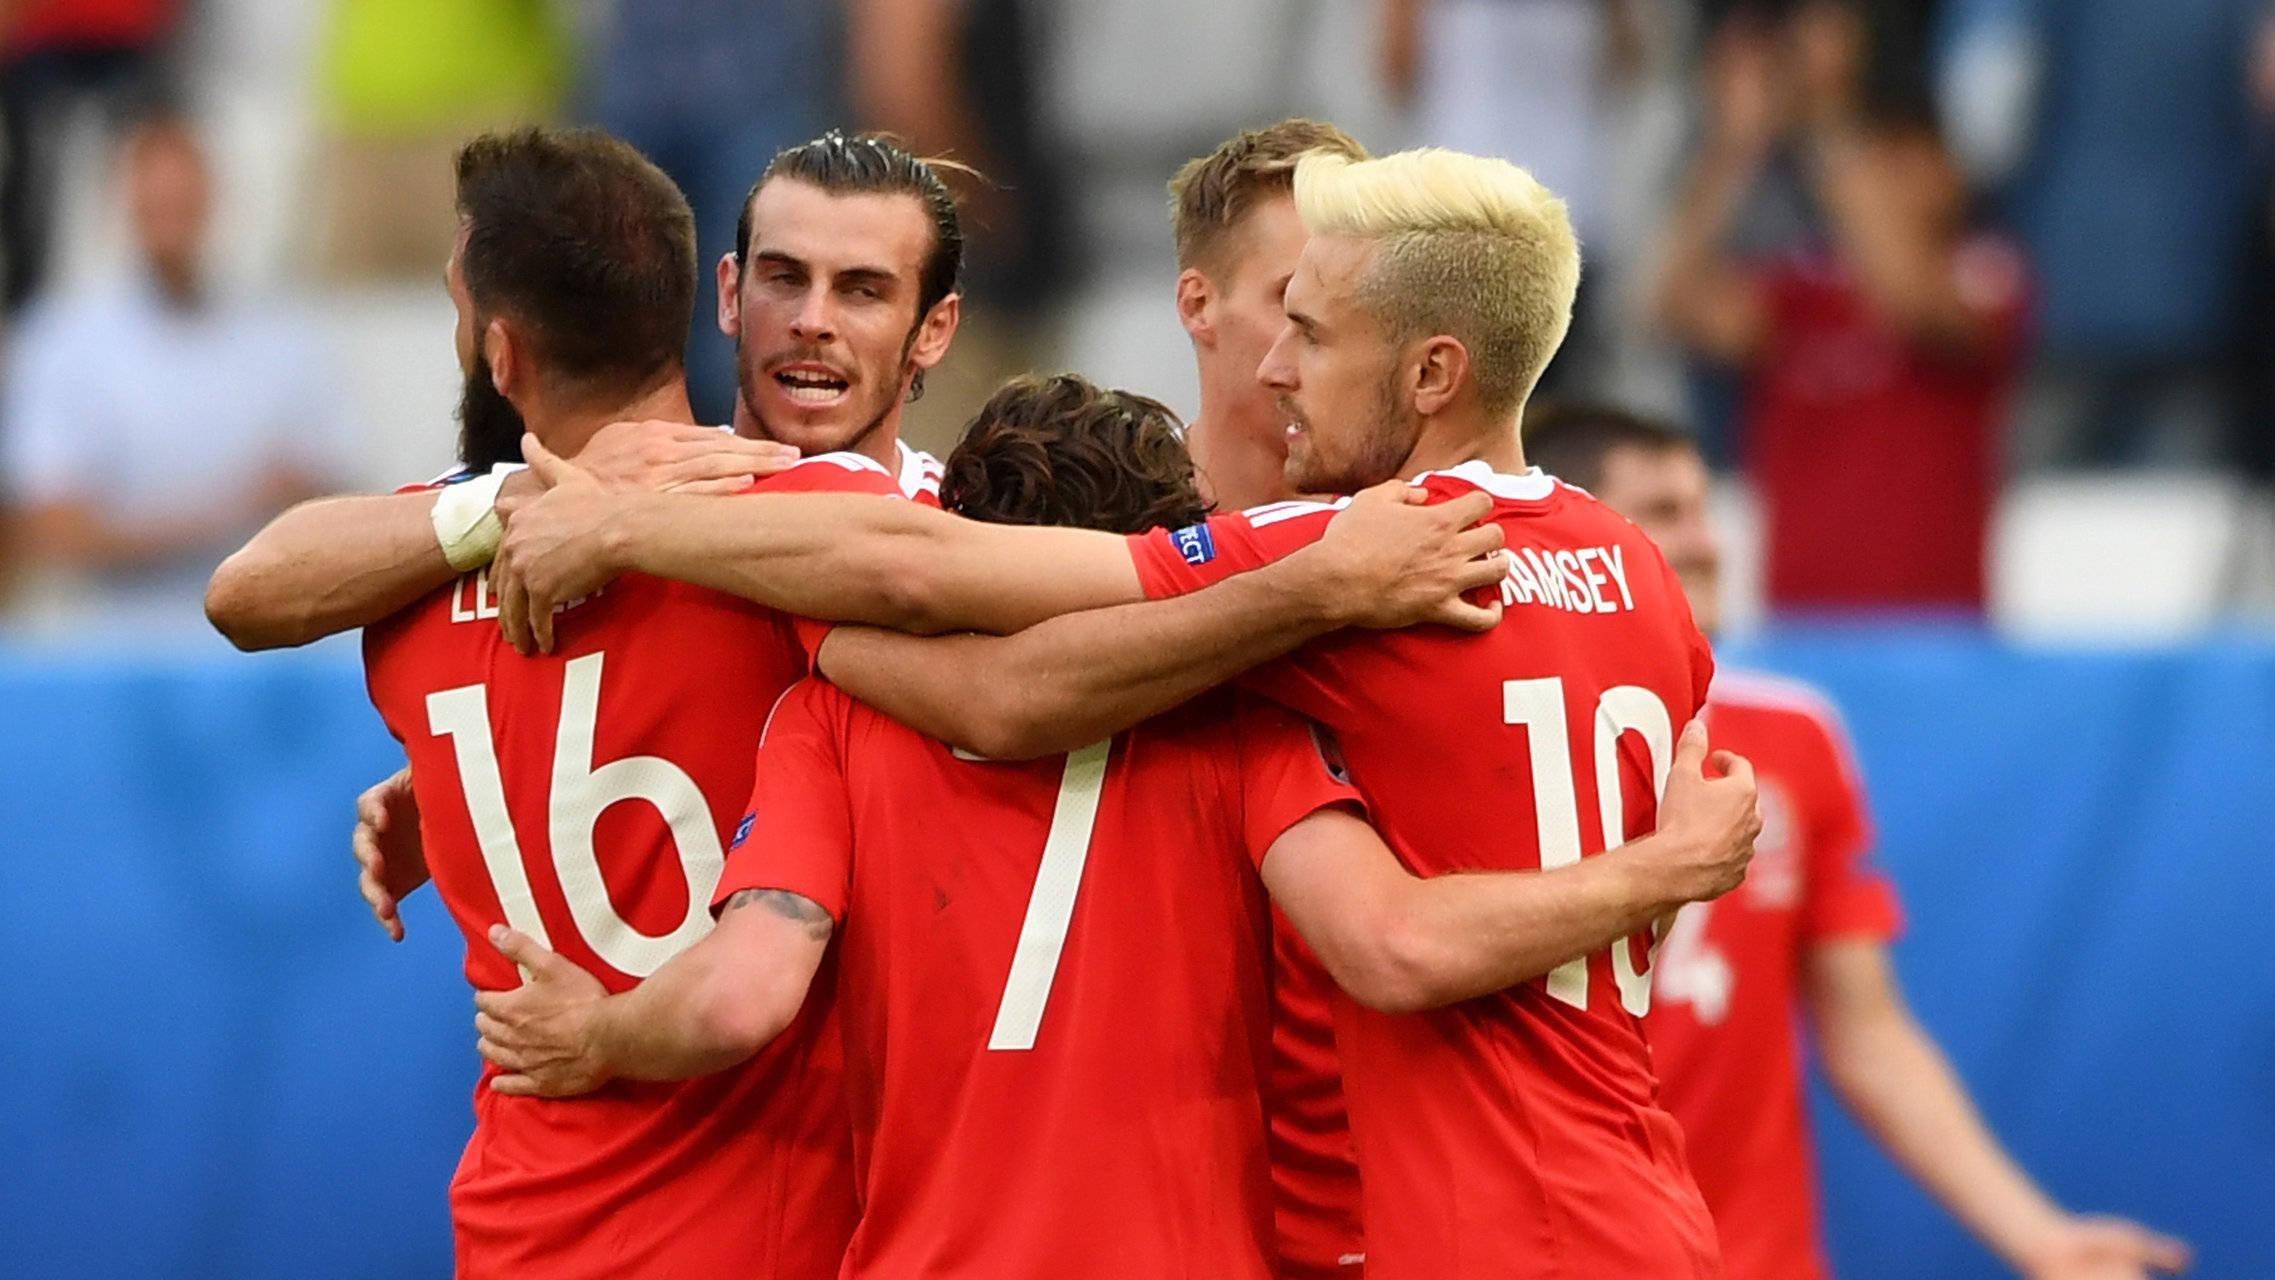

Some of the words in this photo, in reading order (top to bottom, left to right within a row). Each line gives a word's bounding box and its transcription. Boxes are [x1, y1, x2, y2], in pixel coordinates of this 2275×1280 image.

[1178, 525, 1205, 563] ECT
[425, 651, 726, 985] 16
[952, 738, 1112, 1051] 7
[1503, 676, 1673, 1018] 10
